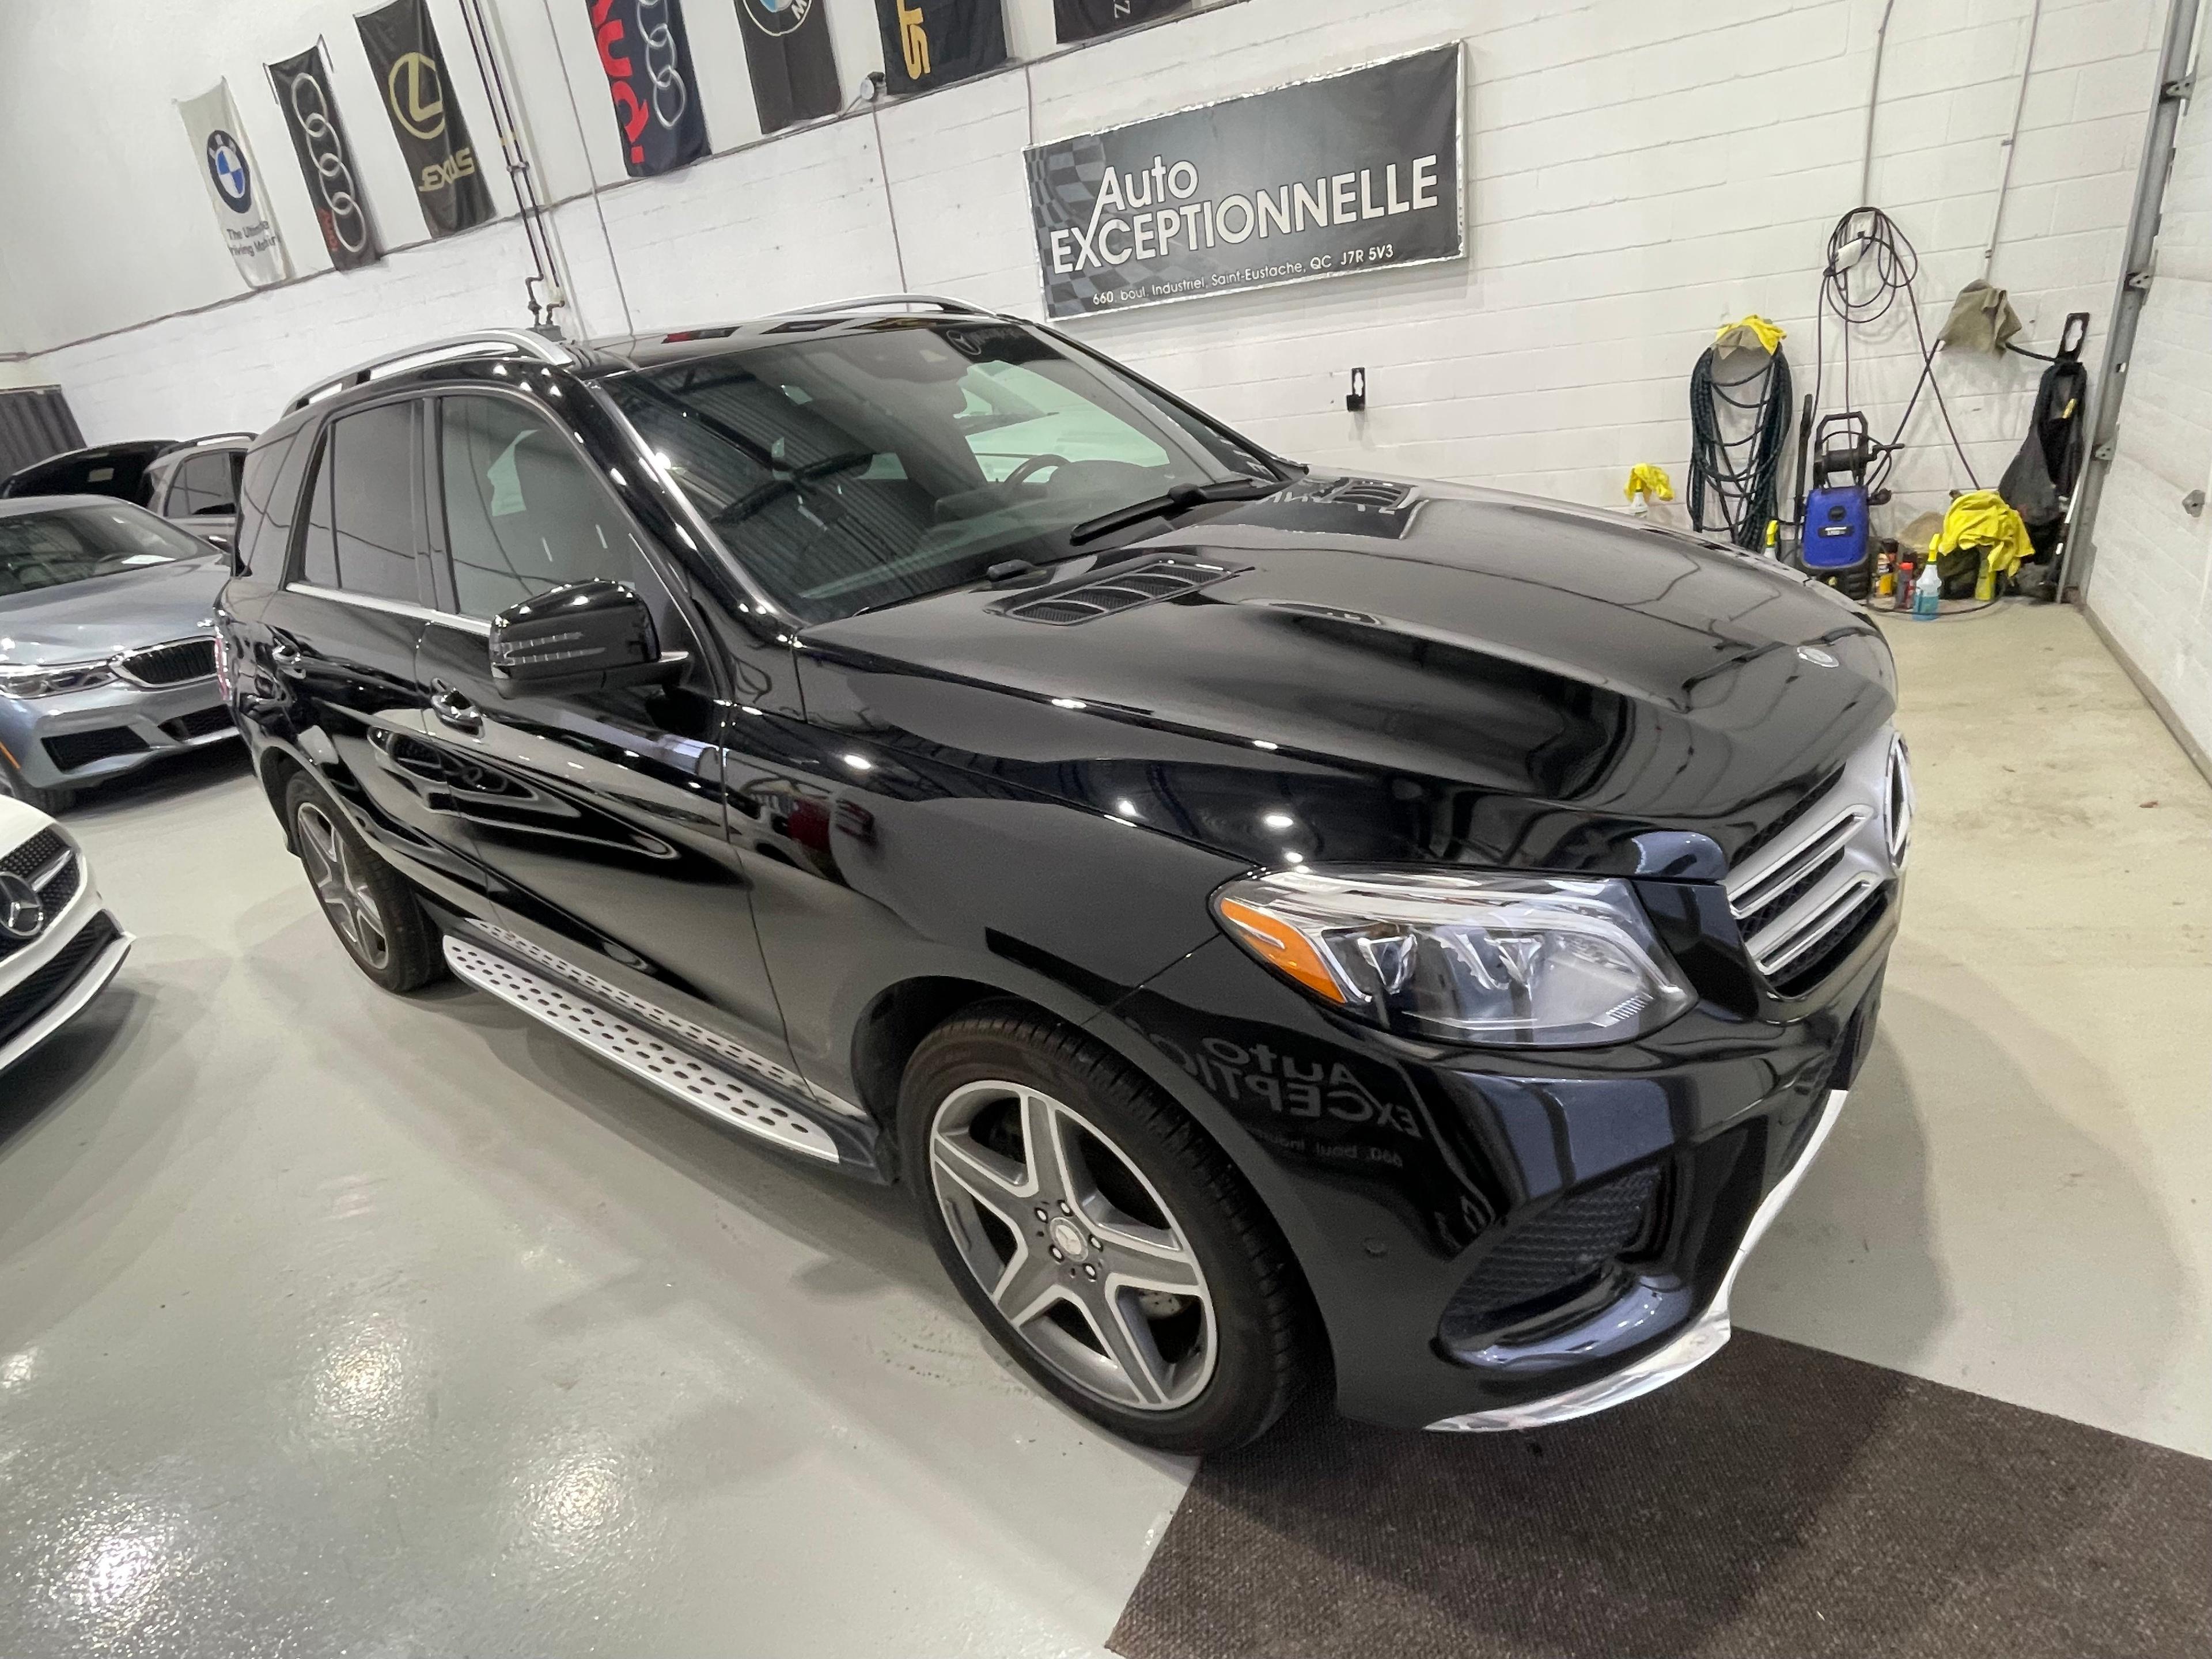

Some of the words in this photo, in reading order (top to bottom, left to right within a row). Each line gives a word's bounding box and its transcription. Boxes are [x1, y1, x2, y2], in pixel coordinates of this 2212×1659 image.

[1092, 155, 1198, 212] Auto
[1050, 154, 1438, 274] EXCEPTIONNELLE
[1211, 262, 1306, 286] Saint-Eustache,
[1310, 255, 1332, 270] QC
[1340, 249, 1364, 266] J7R
[1369, 244, 1394, 260] 5V3
